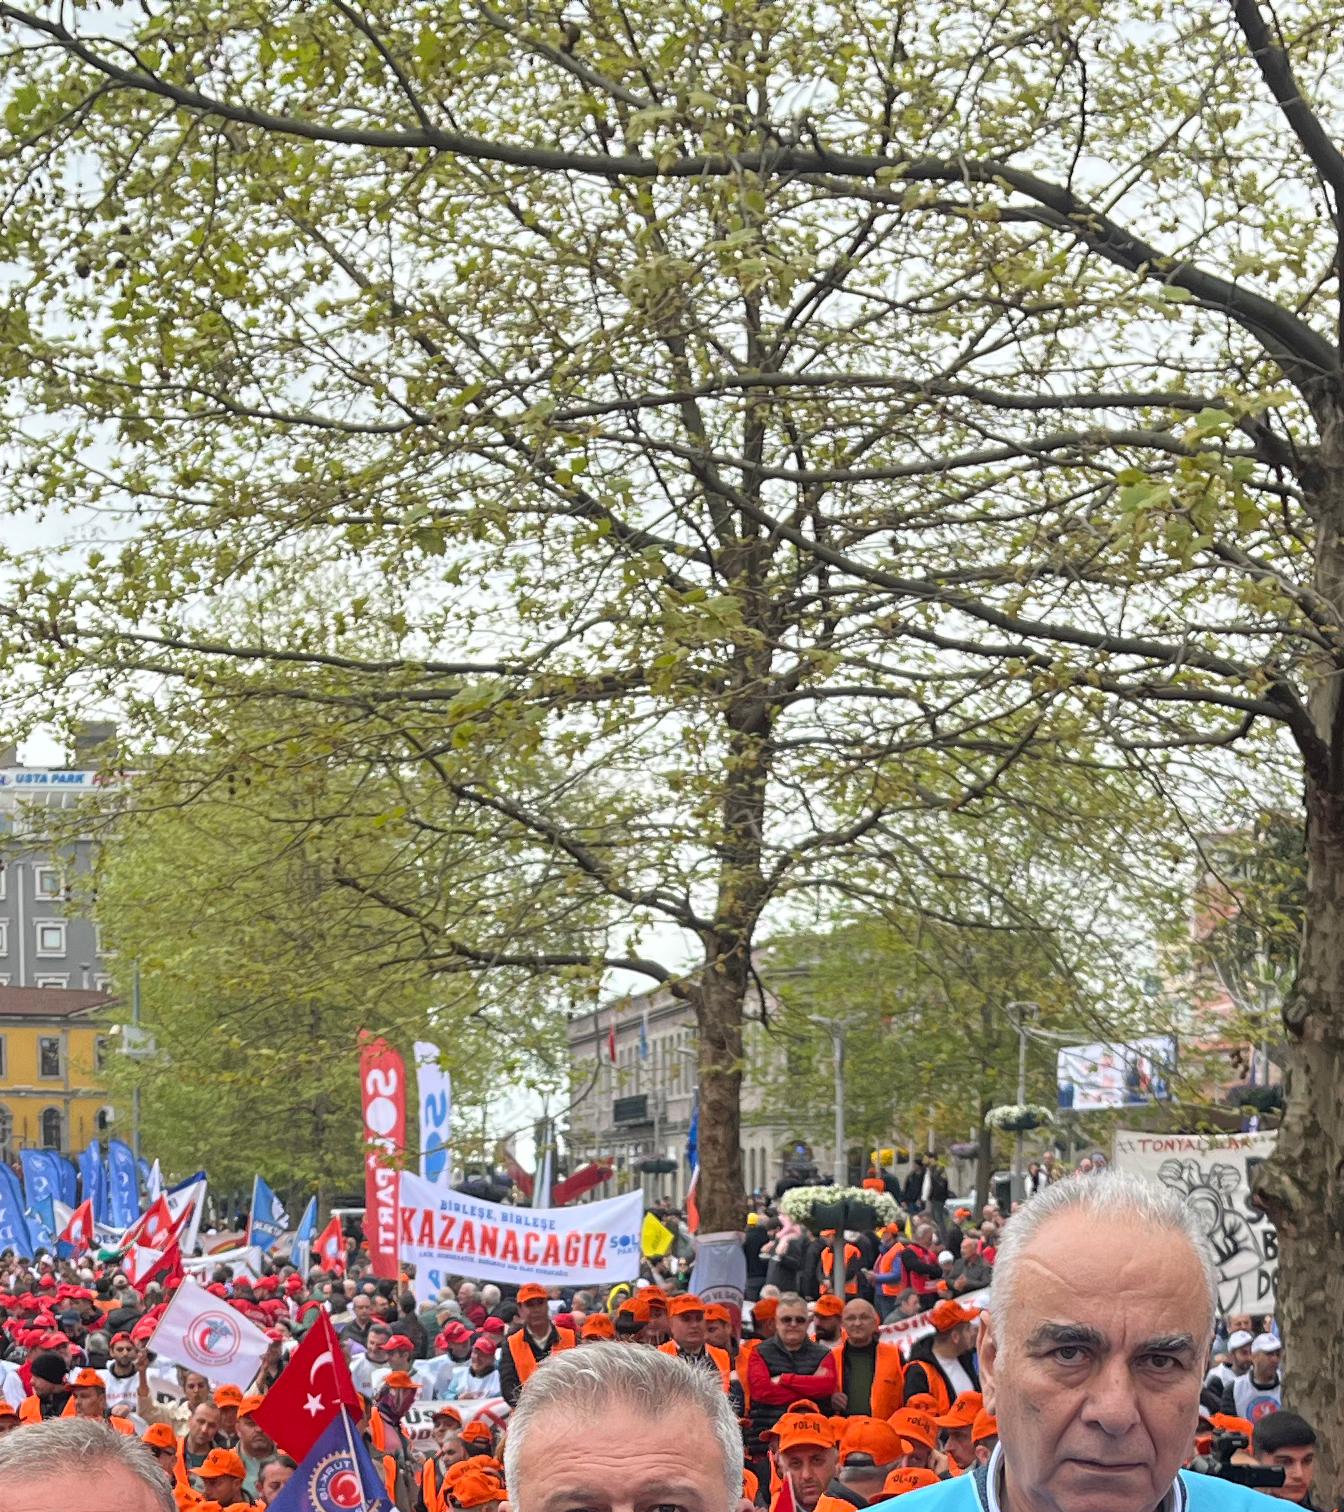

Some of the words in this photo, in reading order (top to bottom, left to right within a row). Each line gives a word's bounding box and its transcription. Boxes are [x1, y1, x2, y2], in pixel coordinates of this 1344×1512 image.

[16, 773, 48, 785] USTA
[51, 772, 85, 784] PARK
[609, 1234, 639, 1249] SOL
